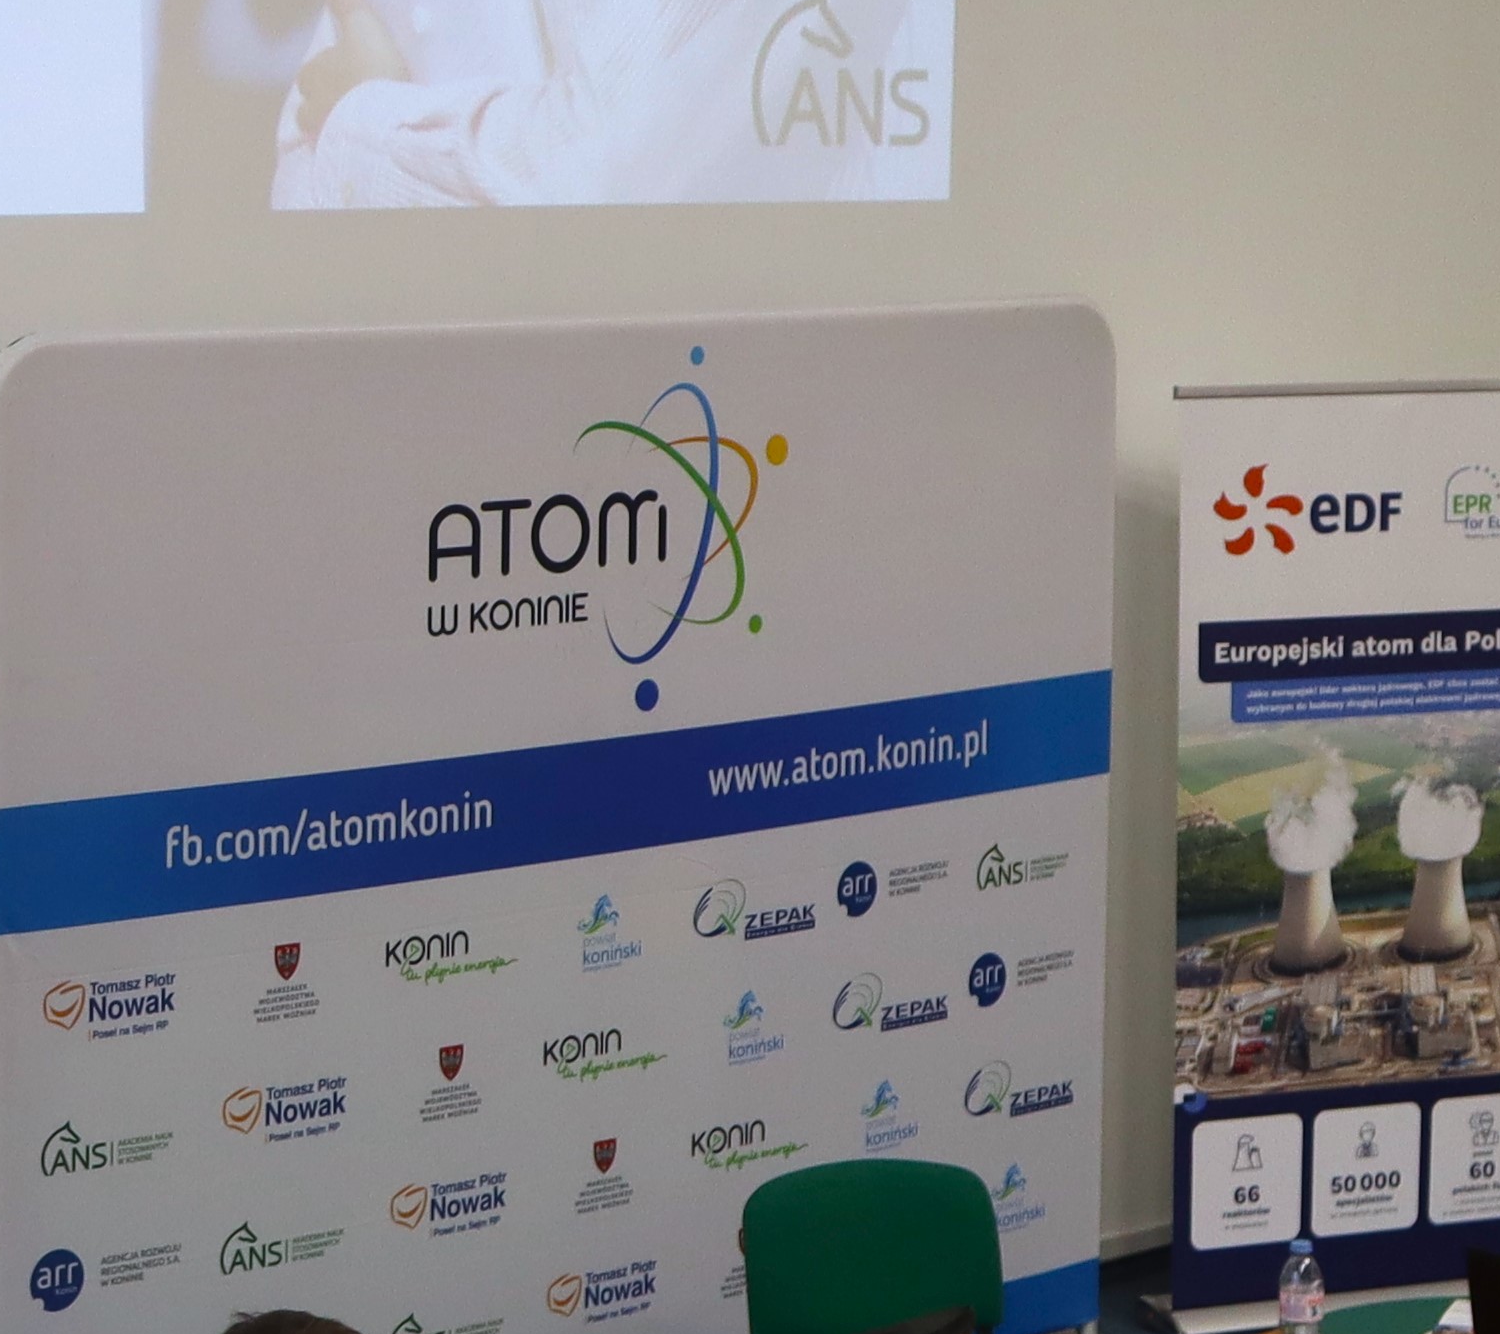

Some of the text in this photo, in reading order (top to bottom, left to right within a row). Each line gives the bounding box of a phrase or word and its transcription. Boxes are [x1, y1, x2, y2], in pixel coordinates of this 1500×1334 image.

[775, 66, 931, 149] ANS
[1452, 493, 1492, 516] EPR
[426, 488, 669, 584] ATOM
[1463, 514, 1484, 531] for
[426, 592, 591, 639] W KONINIE
[1214, 636, 1345, 667] Europejski
[1352, 637, 1414, 658] atom
[1421, 631, 1457, 654] dla
[165, 719, 990, 870] fb.com/atomkonin www.atom.konin.pl
[842, 872, 874, 896] arr
[984, 861, 1024, 888] ANS
[745, 904, 815, 929] ZEPAK
[582, 940, 643, 965] koniński
[90, 972, 176, 996] Tomasz Piotr
[973, 964, 1002, 987] arr
[88, 988, 175, 1022] Nowak
[881, 995, 947, 1022] ZEPAK
[729, 1034, 784, 1061] koniński
[266, 1077, 347, 1100] Tomasz Piotr
[1010, 1080, 1073, 1107] ZEPAK
[265, 1092, 346, 1126] Nowak
[866, 1123, 918, 1148] koniński
[52, 1142, 107, 1176] ANS
[1469, 1160, 1496, 1180] 60
[431, 1172, 507, 1196] Tomasz Piotr
[1234, 1185, 1260, 1204] 66
[1331, 1170, 1401, 1194] 50 000
[430, 1186, 506, 1221] Nowak
[231, 1240, 282, 1272] ANS
[37, 1262, 78, 1289] arr
